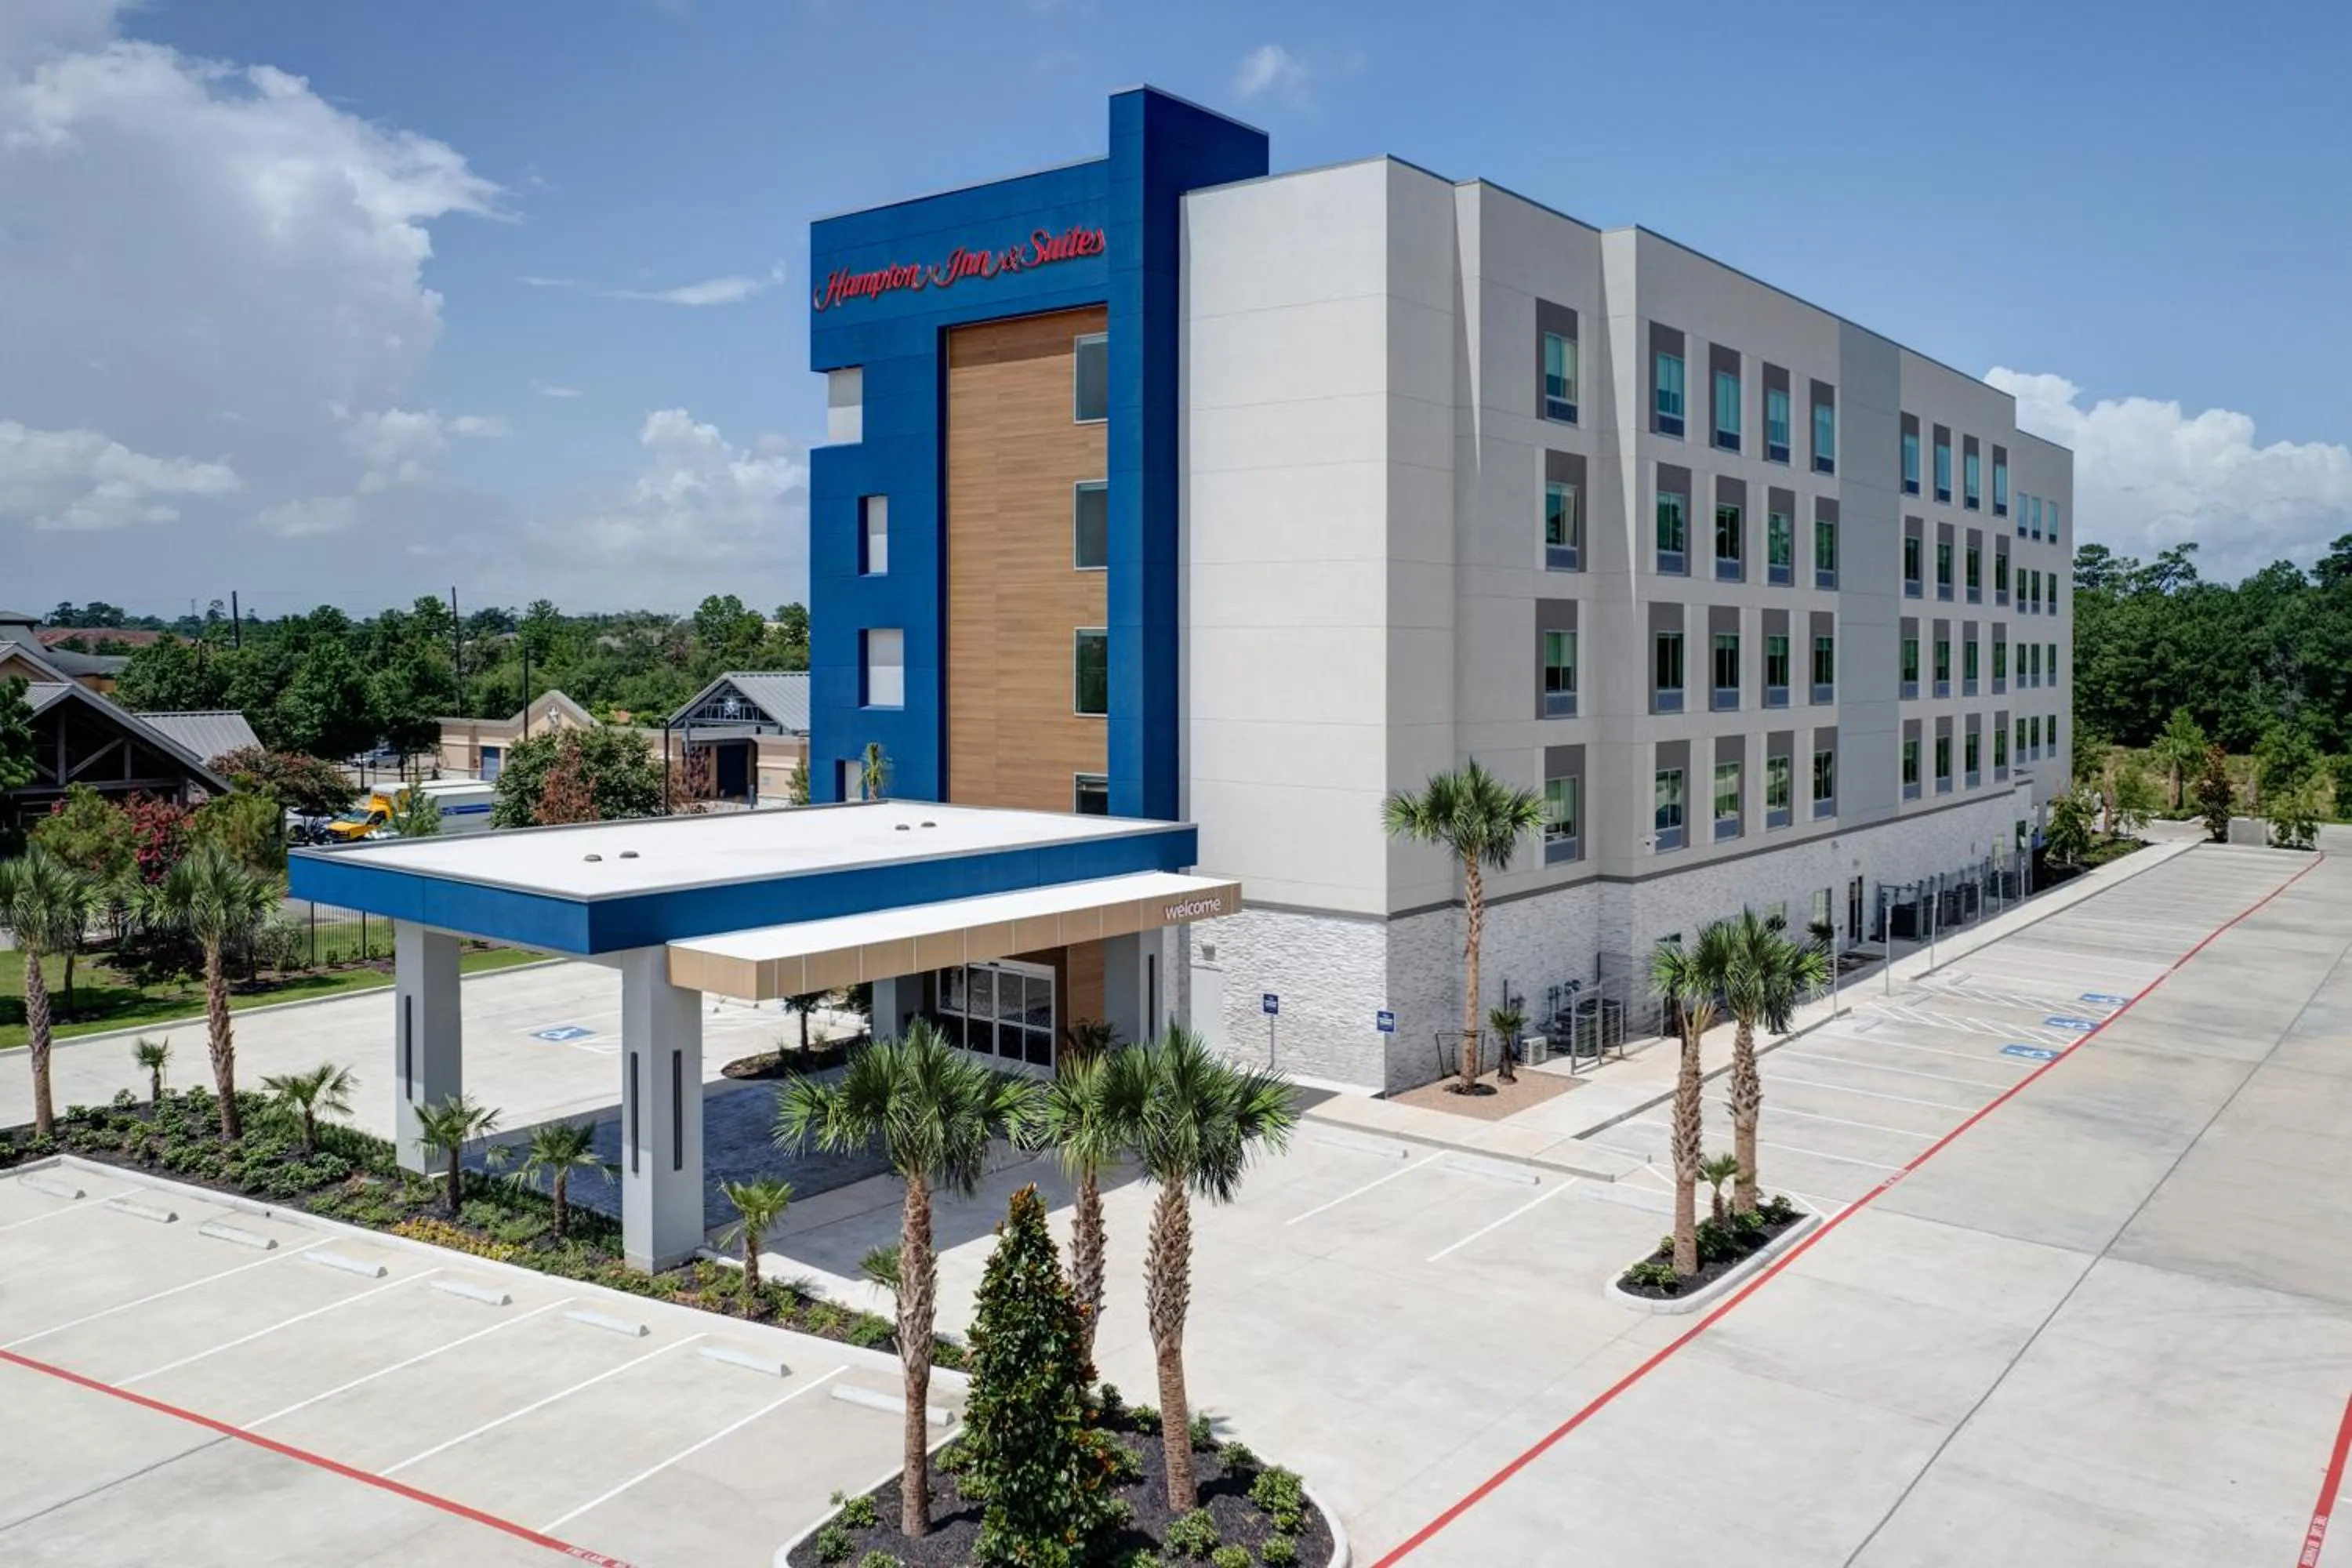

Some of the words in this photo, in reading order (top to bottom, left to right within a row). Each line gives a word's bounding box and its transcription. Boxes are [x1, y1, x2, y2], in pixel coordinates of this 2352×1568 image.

[814, 263, 931, 313] Hampton
[934, 245, 1004, 287] Inn
[1019, 224, 1106, 267] Suites
[1164, 898, 1221, 919] welcome
